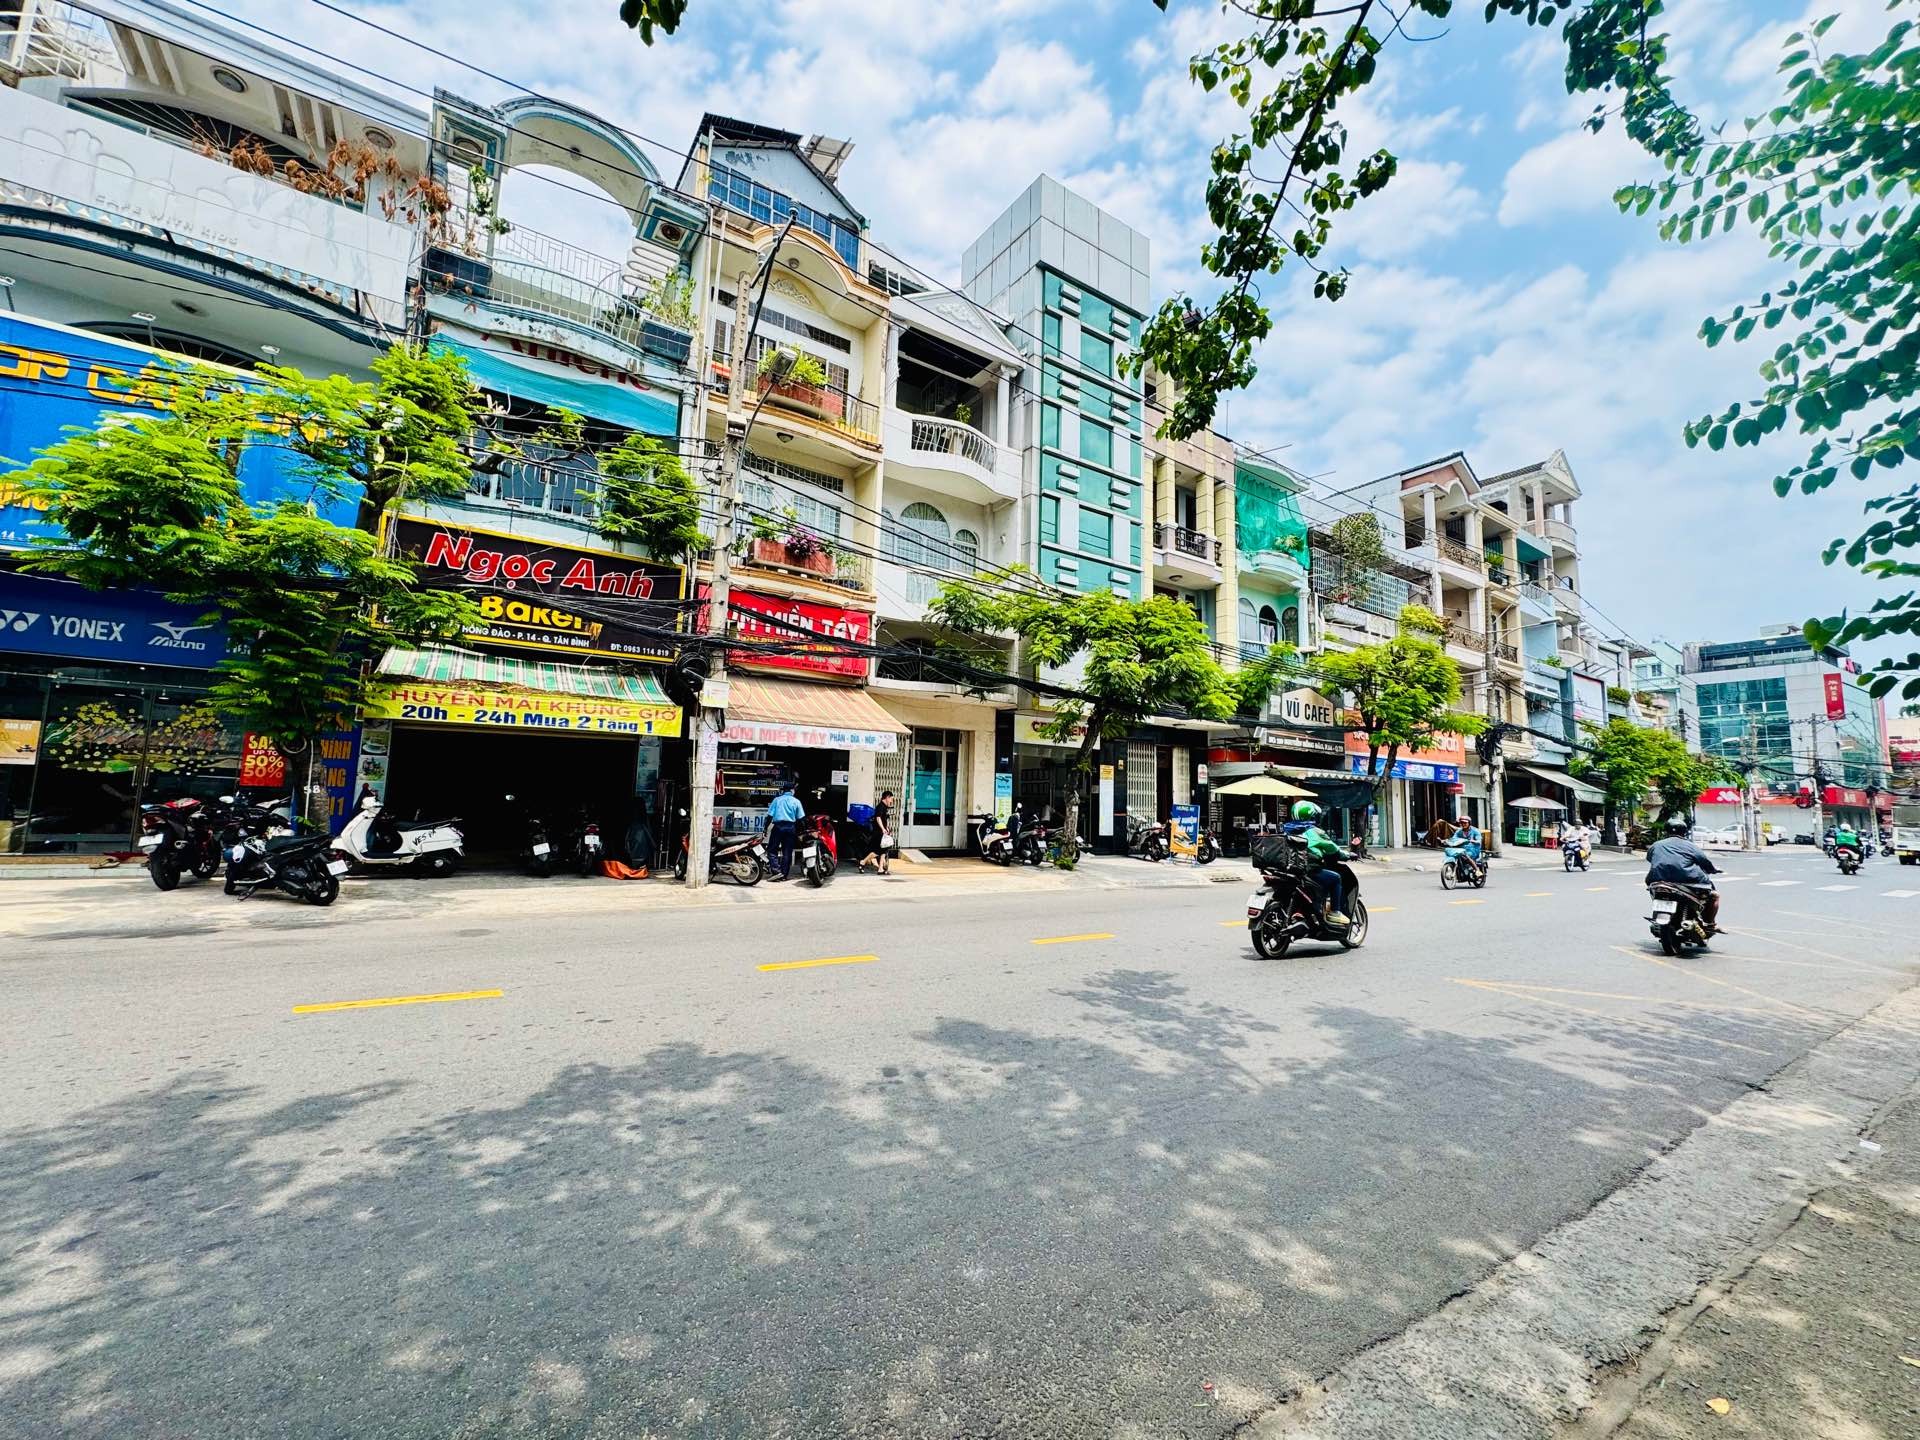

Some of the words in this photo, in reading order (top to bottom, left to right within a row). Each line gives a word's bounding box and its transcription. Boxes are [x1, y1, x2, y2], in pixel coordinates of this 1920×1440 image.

[423, 532, 556, 589] Ngọc
[560, 557, 655, 600] Anh
[50, 615, 126, 642] YONEX
[147, 636, 206, 651] MIZUNO
[401, 704, 448, 720] 20h
[474, 709, 517, 724] 24h
[523, 713, 570, 728] Mua
[577, 715, 592, 729] 2
[597, 718, 639, 733] Tặng
[644, 721, 654, 734] 1
[549, 700, 631, 716] KHUNG
[1304, 703, 1330, 725] CAFE
[245, 754, 284, 768] 50%
